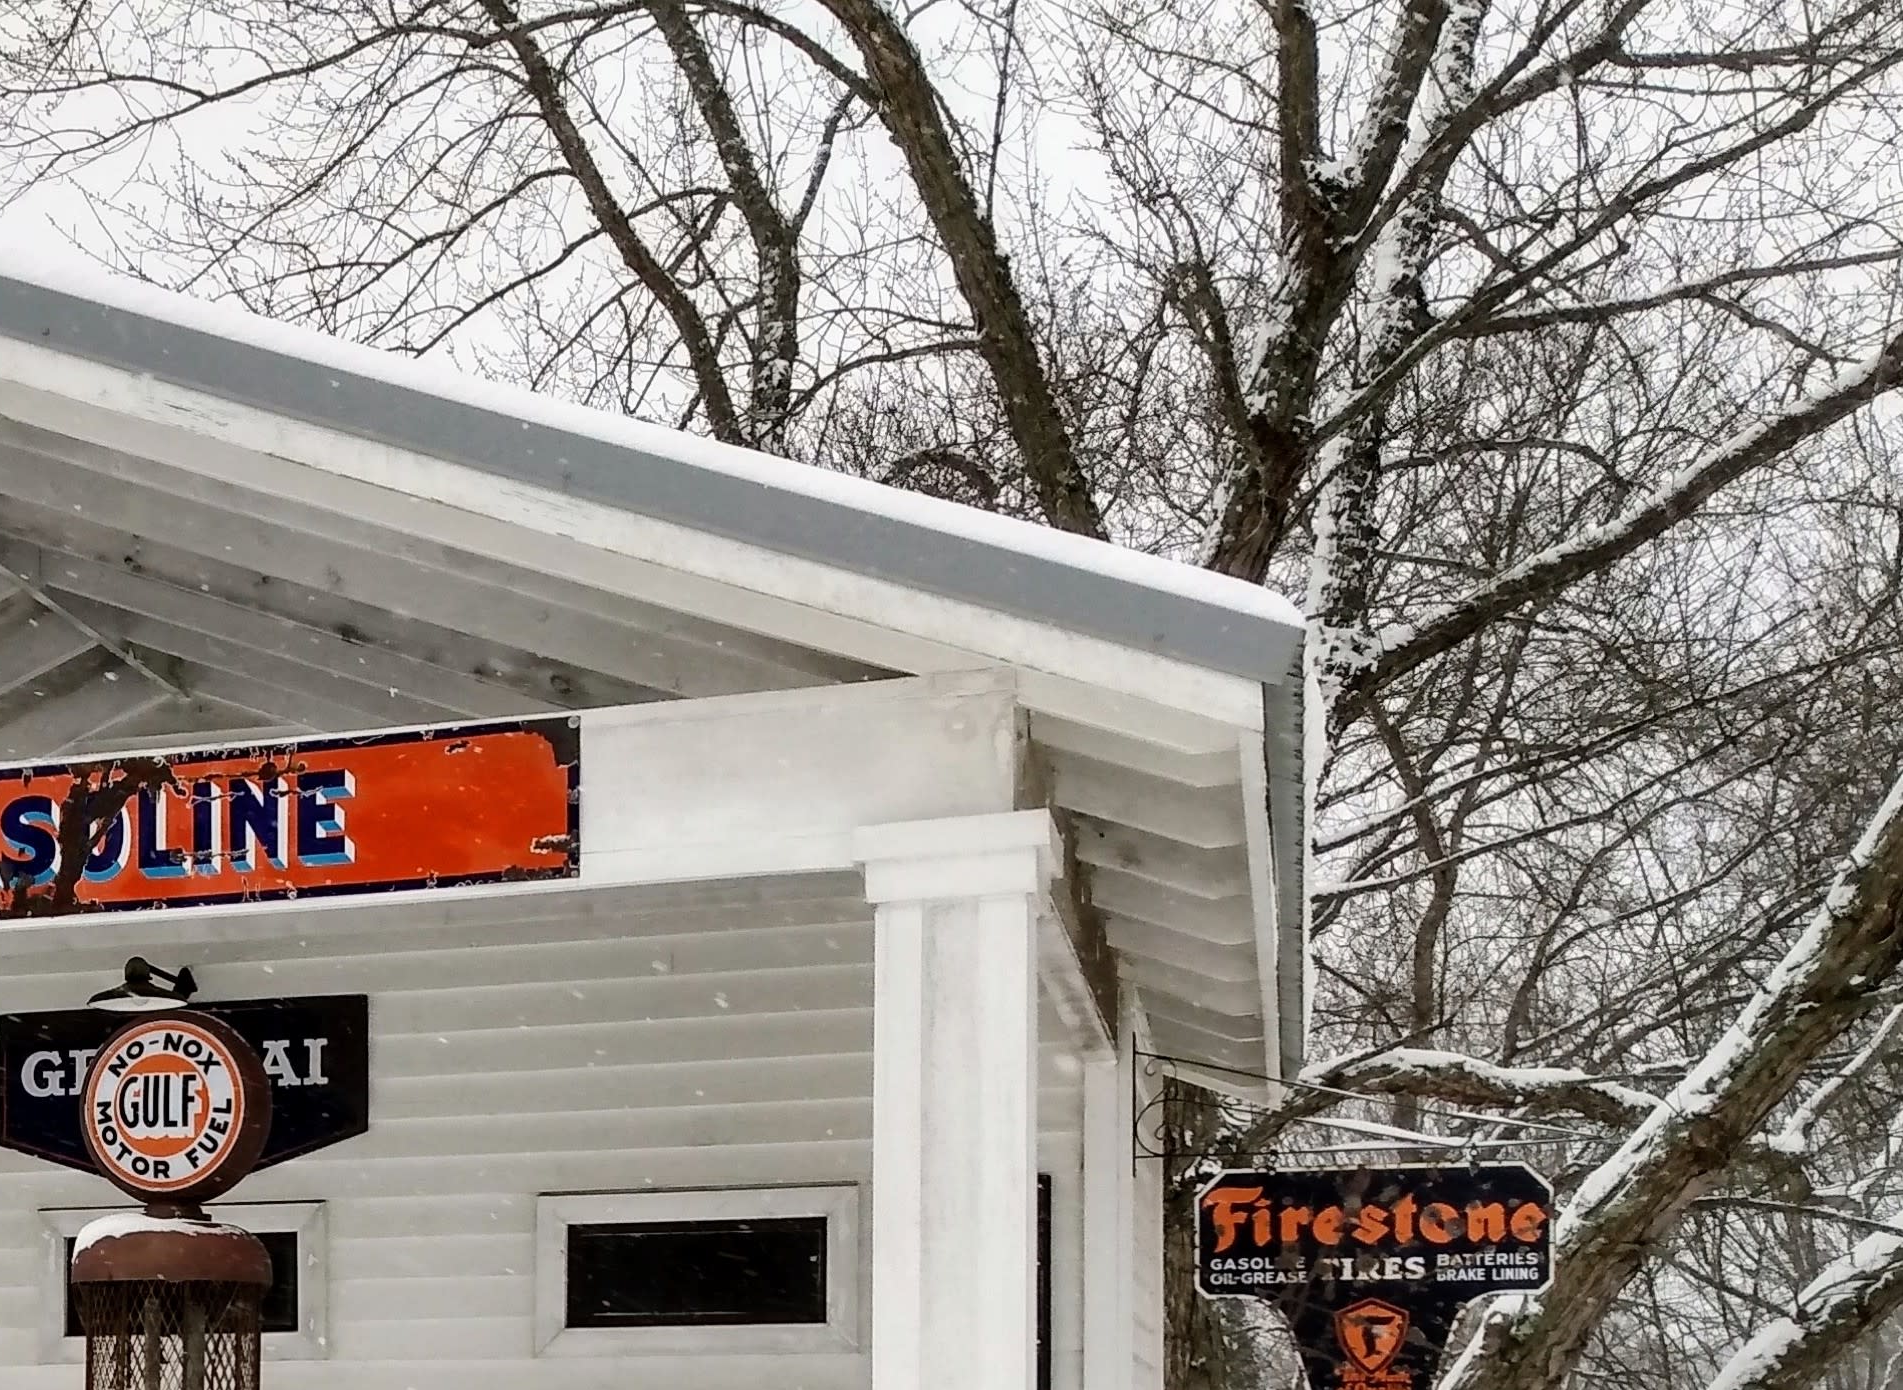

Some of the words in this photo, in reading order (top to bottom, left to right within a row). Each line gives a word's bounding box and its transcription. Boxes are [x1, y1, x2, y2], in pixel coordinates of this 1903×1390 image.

[108, 1031, 222, 1078] NO-NOX
[119, 1072, 199, 1130] GULF
[98, 1100, 170, 1179] MOTOR
[188, 1097, 232, 1170] FUEL
[1202, 1186, 1548, 1253] Firestone
[1209, 1256, 1306, 1271] GASOLE
[1436, 1252, 1539, 1266] BATTERIES
[1436, 1267, 1486, 1281] BRAKE
[1491, 1267, 1539, 1281] LINING
[1209, 1270, 1308, 1285] OIL-GREASE
